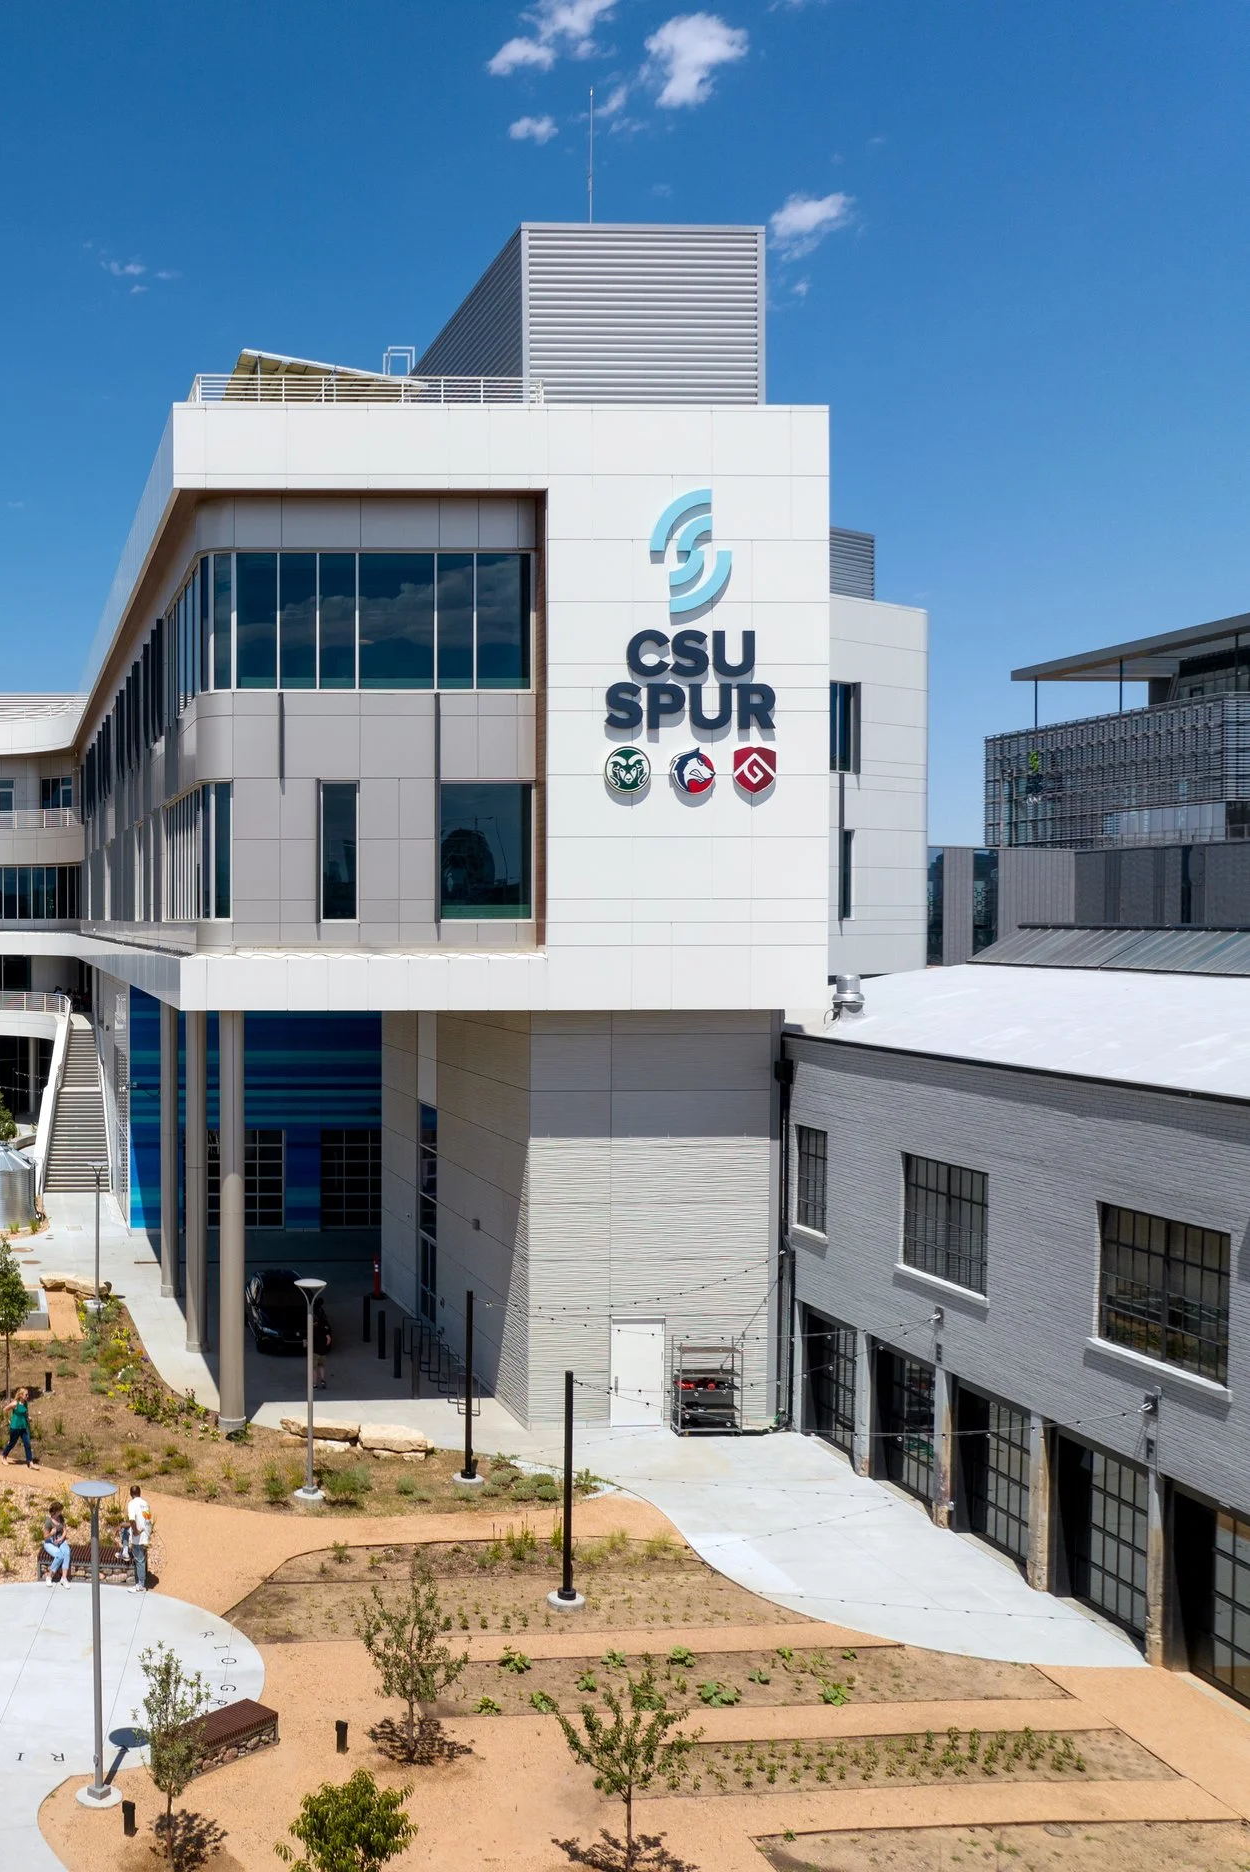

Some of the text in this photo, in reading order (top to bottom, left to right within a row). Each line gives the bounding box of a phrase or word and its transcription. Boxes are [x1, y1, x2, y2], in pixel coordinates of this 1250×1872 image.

[627, 629, 756, 678] CSU
[604, 681, 776, 730] SPUR
[1146, 1437, 1155, 1460] F
